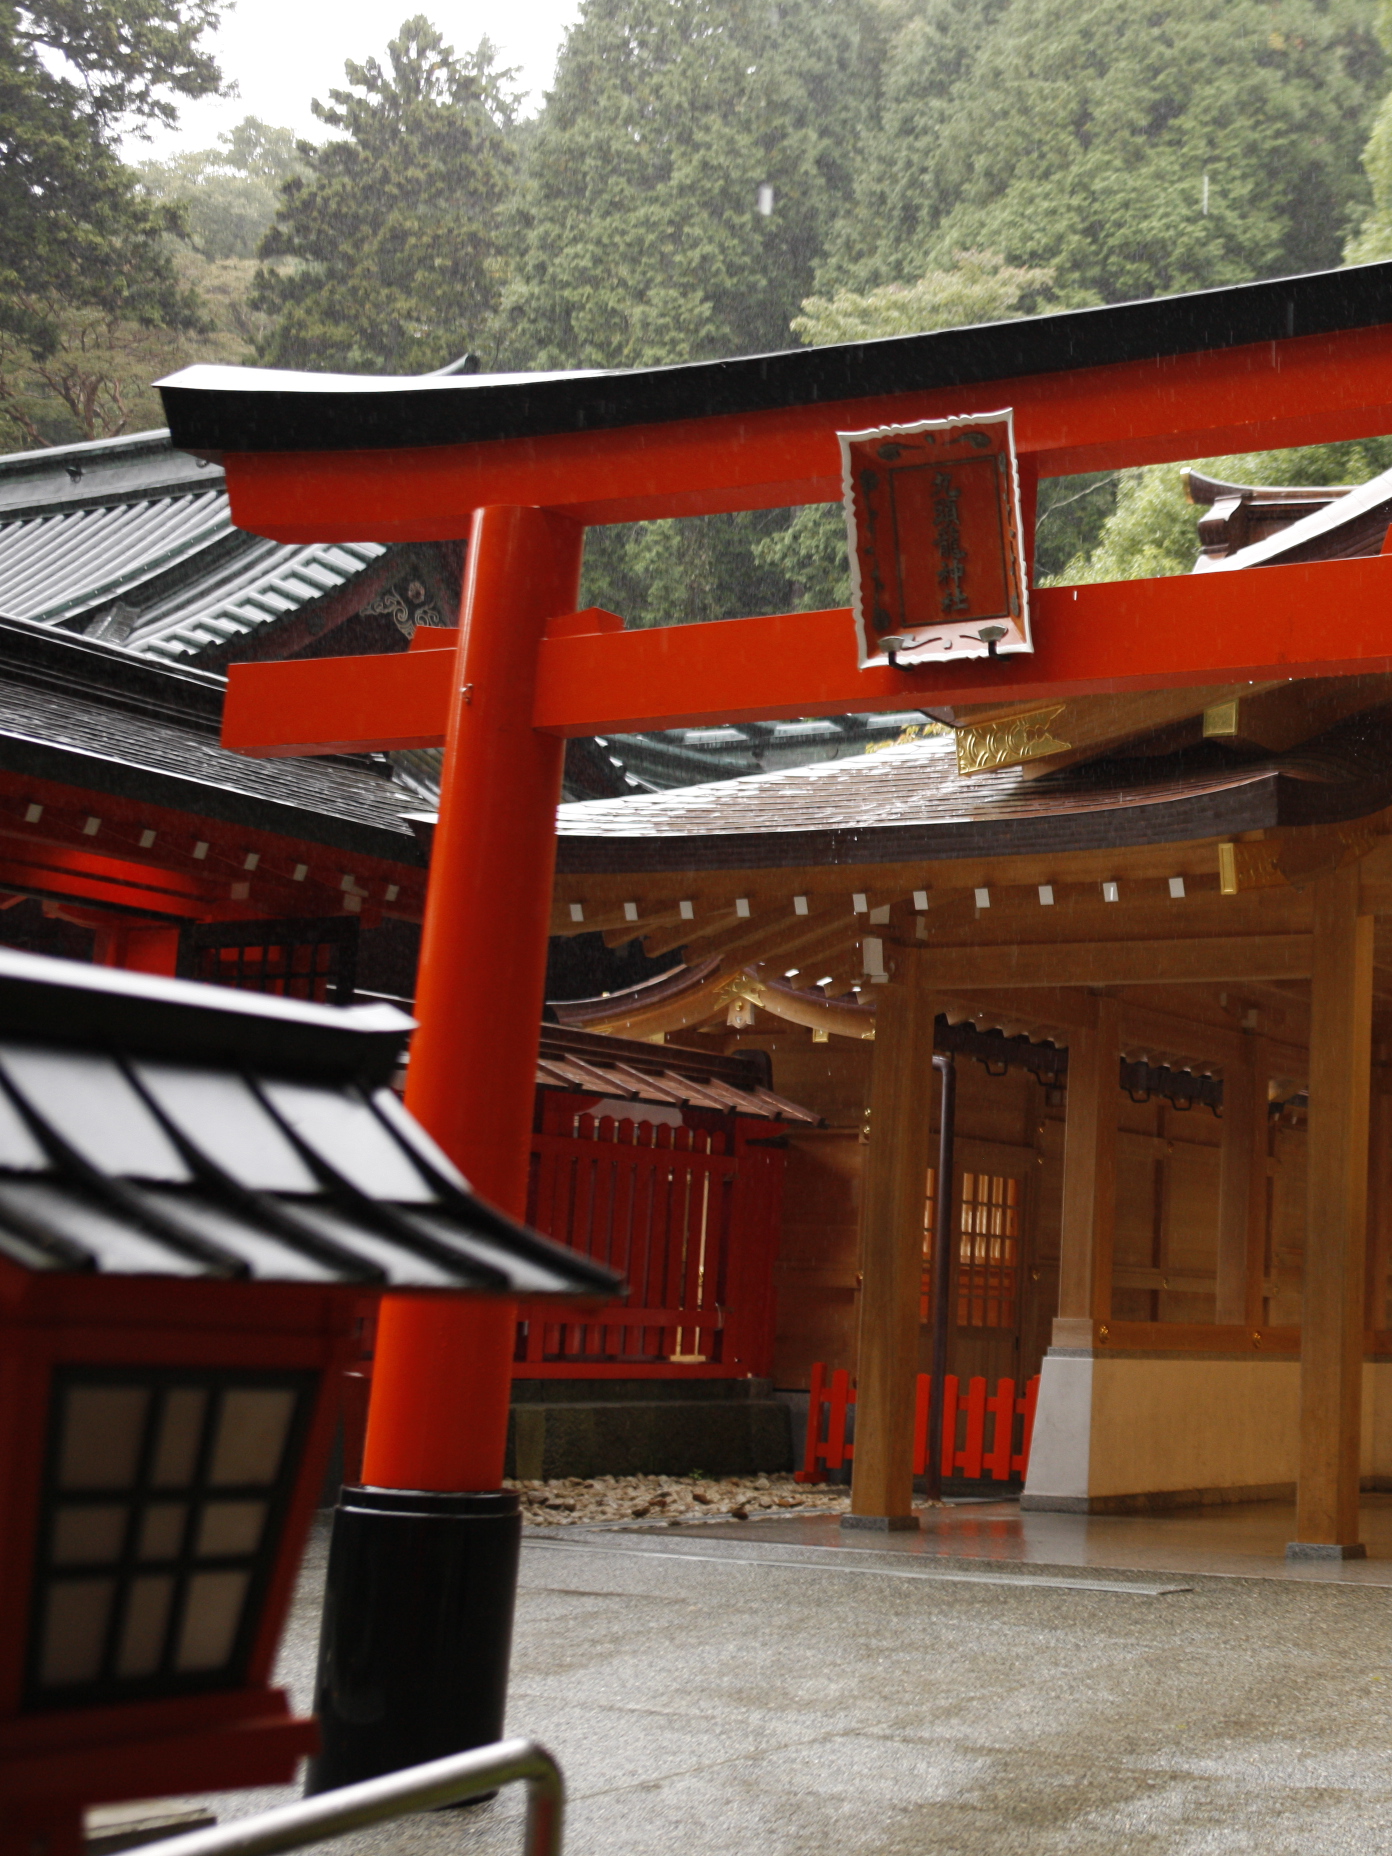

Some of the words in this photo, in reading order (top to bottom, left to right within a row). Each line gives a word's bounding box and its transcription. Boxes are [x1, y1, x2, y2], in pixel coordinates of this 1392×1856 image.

[932, 472, 968, 612] 九頭龍神社
